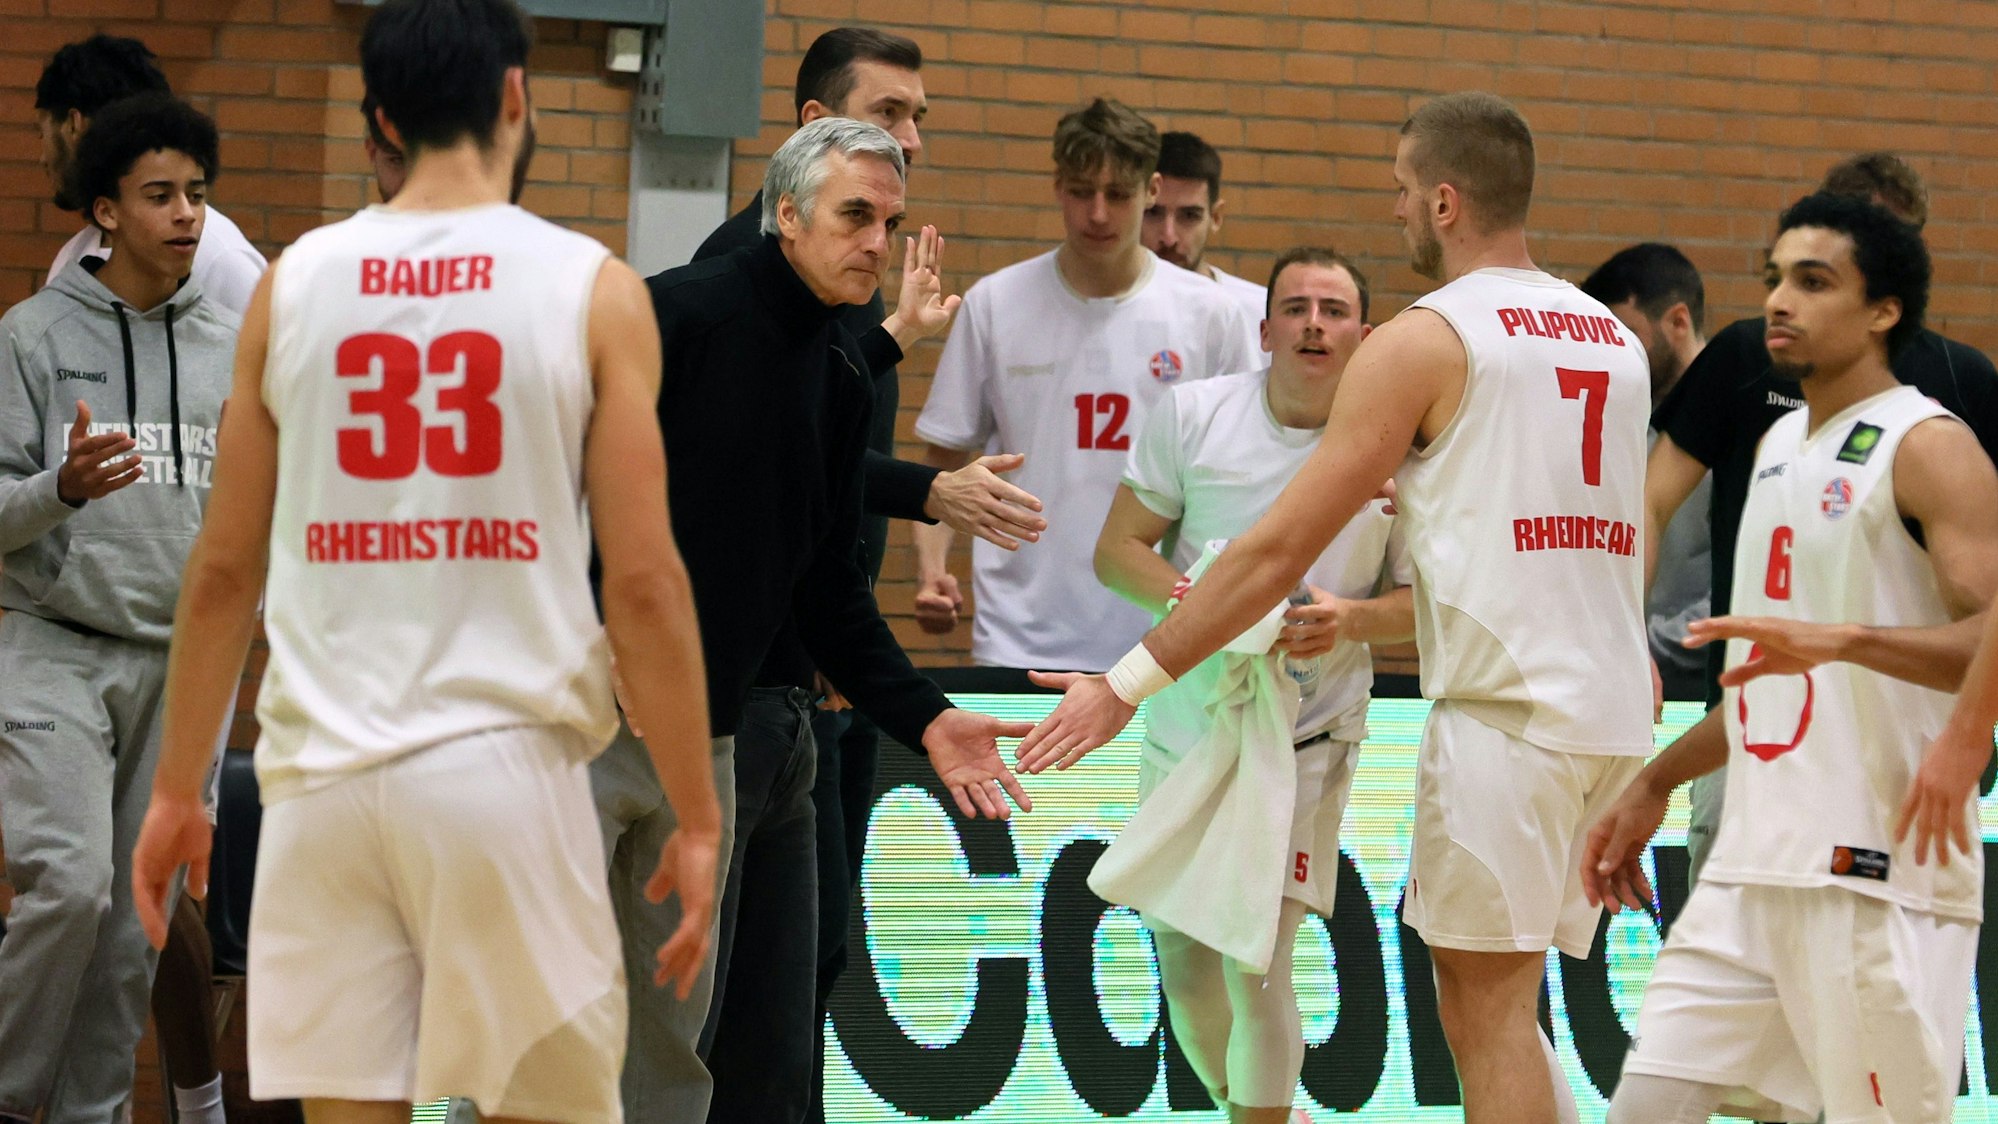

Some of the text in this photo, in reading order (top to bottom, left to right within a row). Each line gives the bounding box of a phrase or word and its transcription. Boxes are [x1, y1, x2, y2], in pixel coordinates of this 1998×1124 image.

[360, 255, 493, 297] BAUER
[1497, 308, 1625, 346] PILIPOVIC
[57, 369, 107, 384] SPALDING
[336, 331, 503, 481] 33
[1074, 392, 1130, 451] 12
[1555, 367, 1609, 486] 7
[307, 517, 539, 562] RHEINSTARS
[1765, 525, 1793, 600] 6
[4, 721, 55, 733] SPALDING
[1294, 851, 1309, 884] 5
